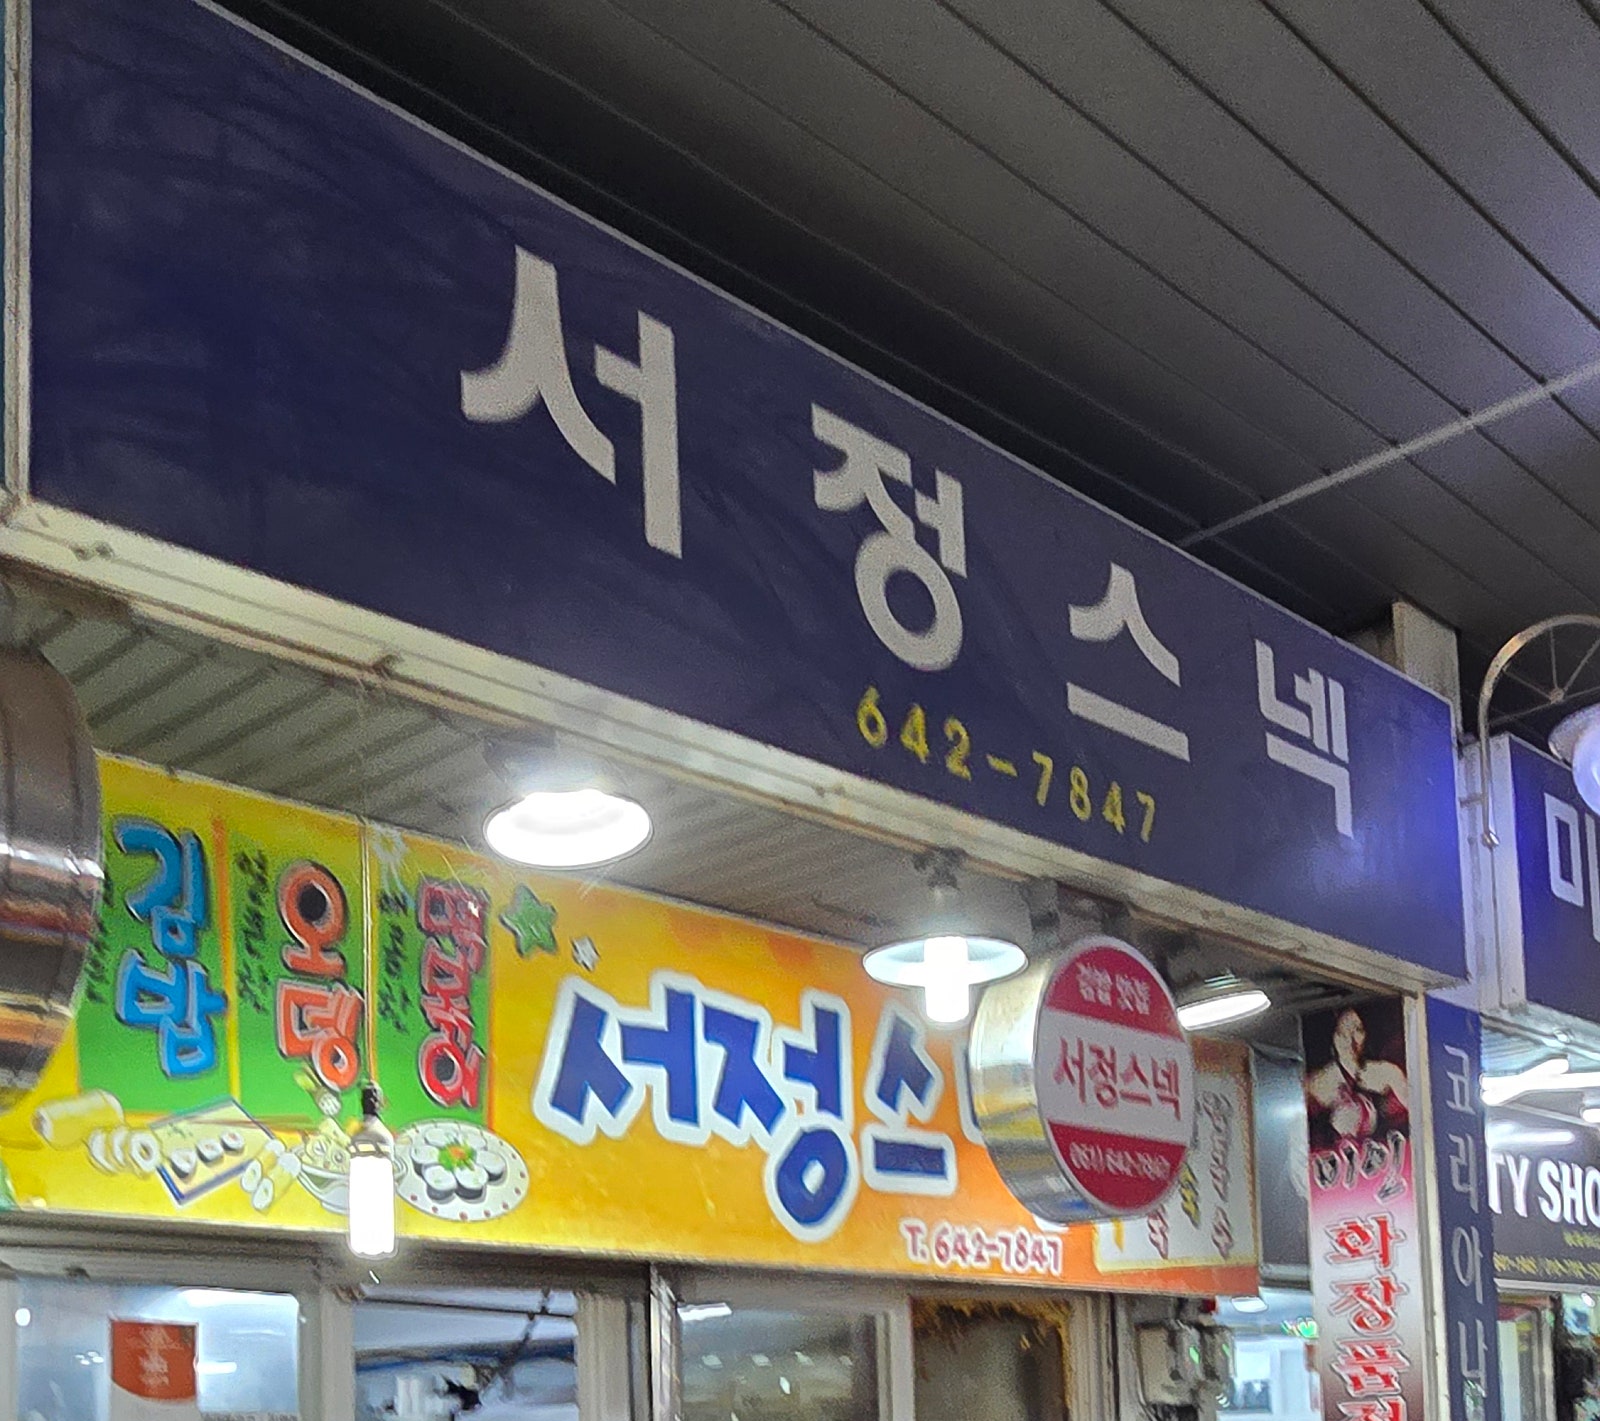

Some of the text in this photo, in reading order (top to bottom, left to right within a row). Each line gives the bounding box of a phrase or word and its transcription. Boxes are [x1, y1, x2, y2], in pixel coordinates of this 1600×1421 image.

[461, 245, 1353, 838] 서정스넥
[856, 687, 1157, 843] 642-7847
[113, 814, 229, 1082] 김밥
[275, 857, 366, 1092] 오뎅
[536, 970, 982, 1240] 서정스
[1053, 1036, 1183, 1122] 서정스넥
